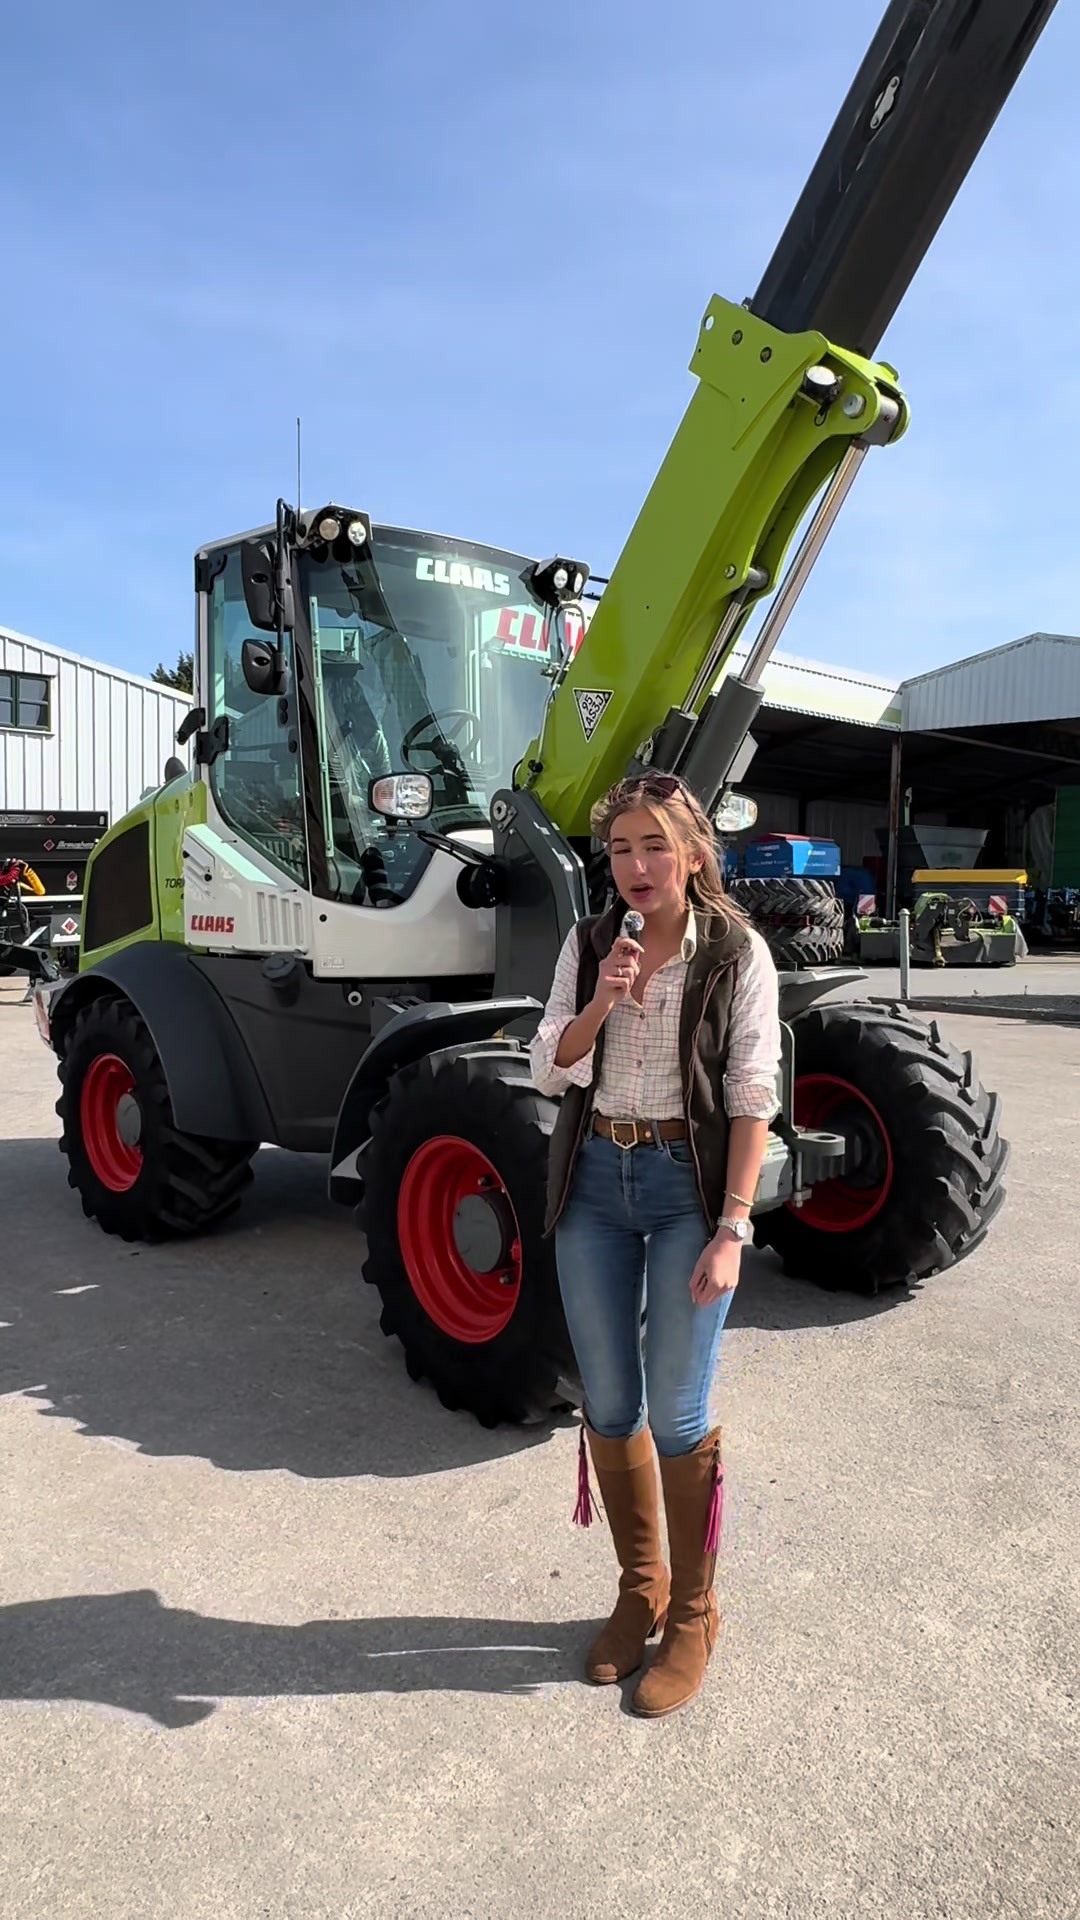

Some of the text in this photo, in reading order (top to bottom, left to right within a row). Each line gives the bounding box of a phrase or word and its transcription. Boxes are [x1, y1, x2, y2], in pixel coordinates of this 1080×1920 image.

[416, 557, 511, 596] CLAAS
[581, 694, 594, 711] 95
[191, 914, 234, 933] CLAAS
